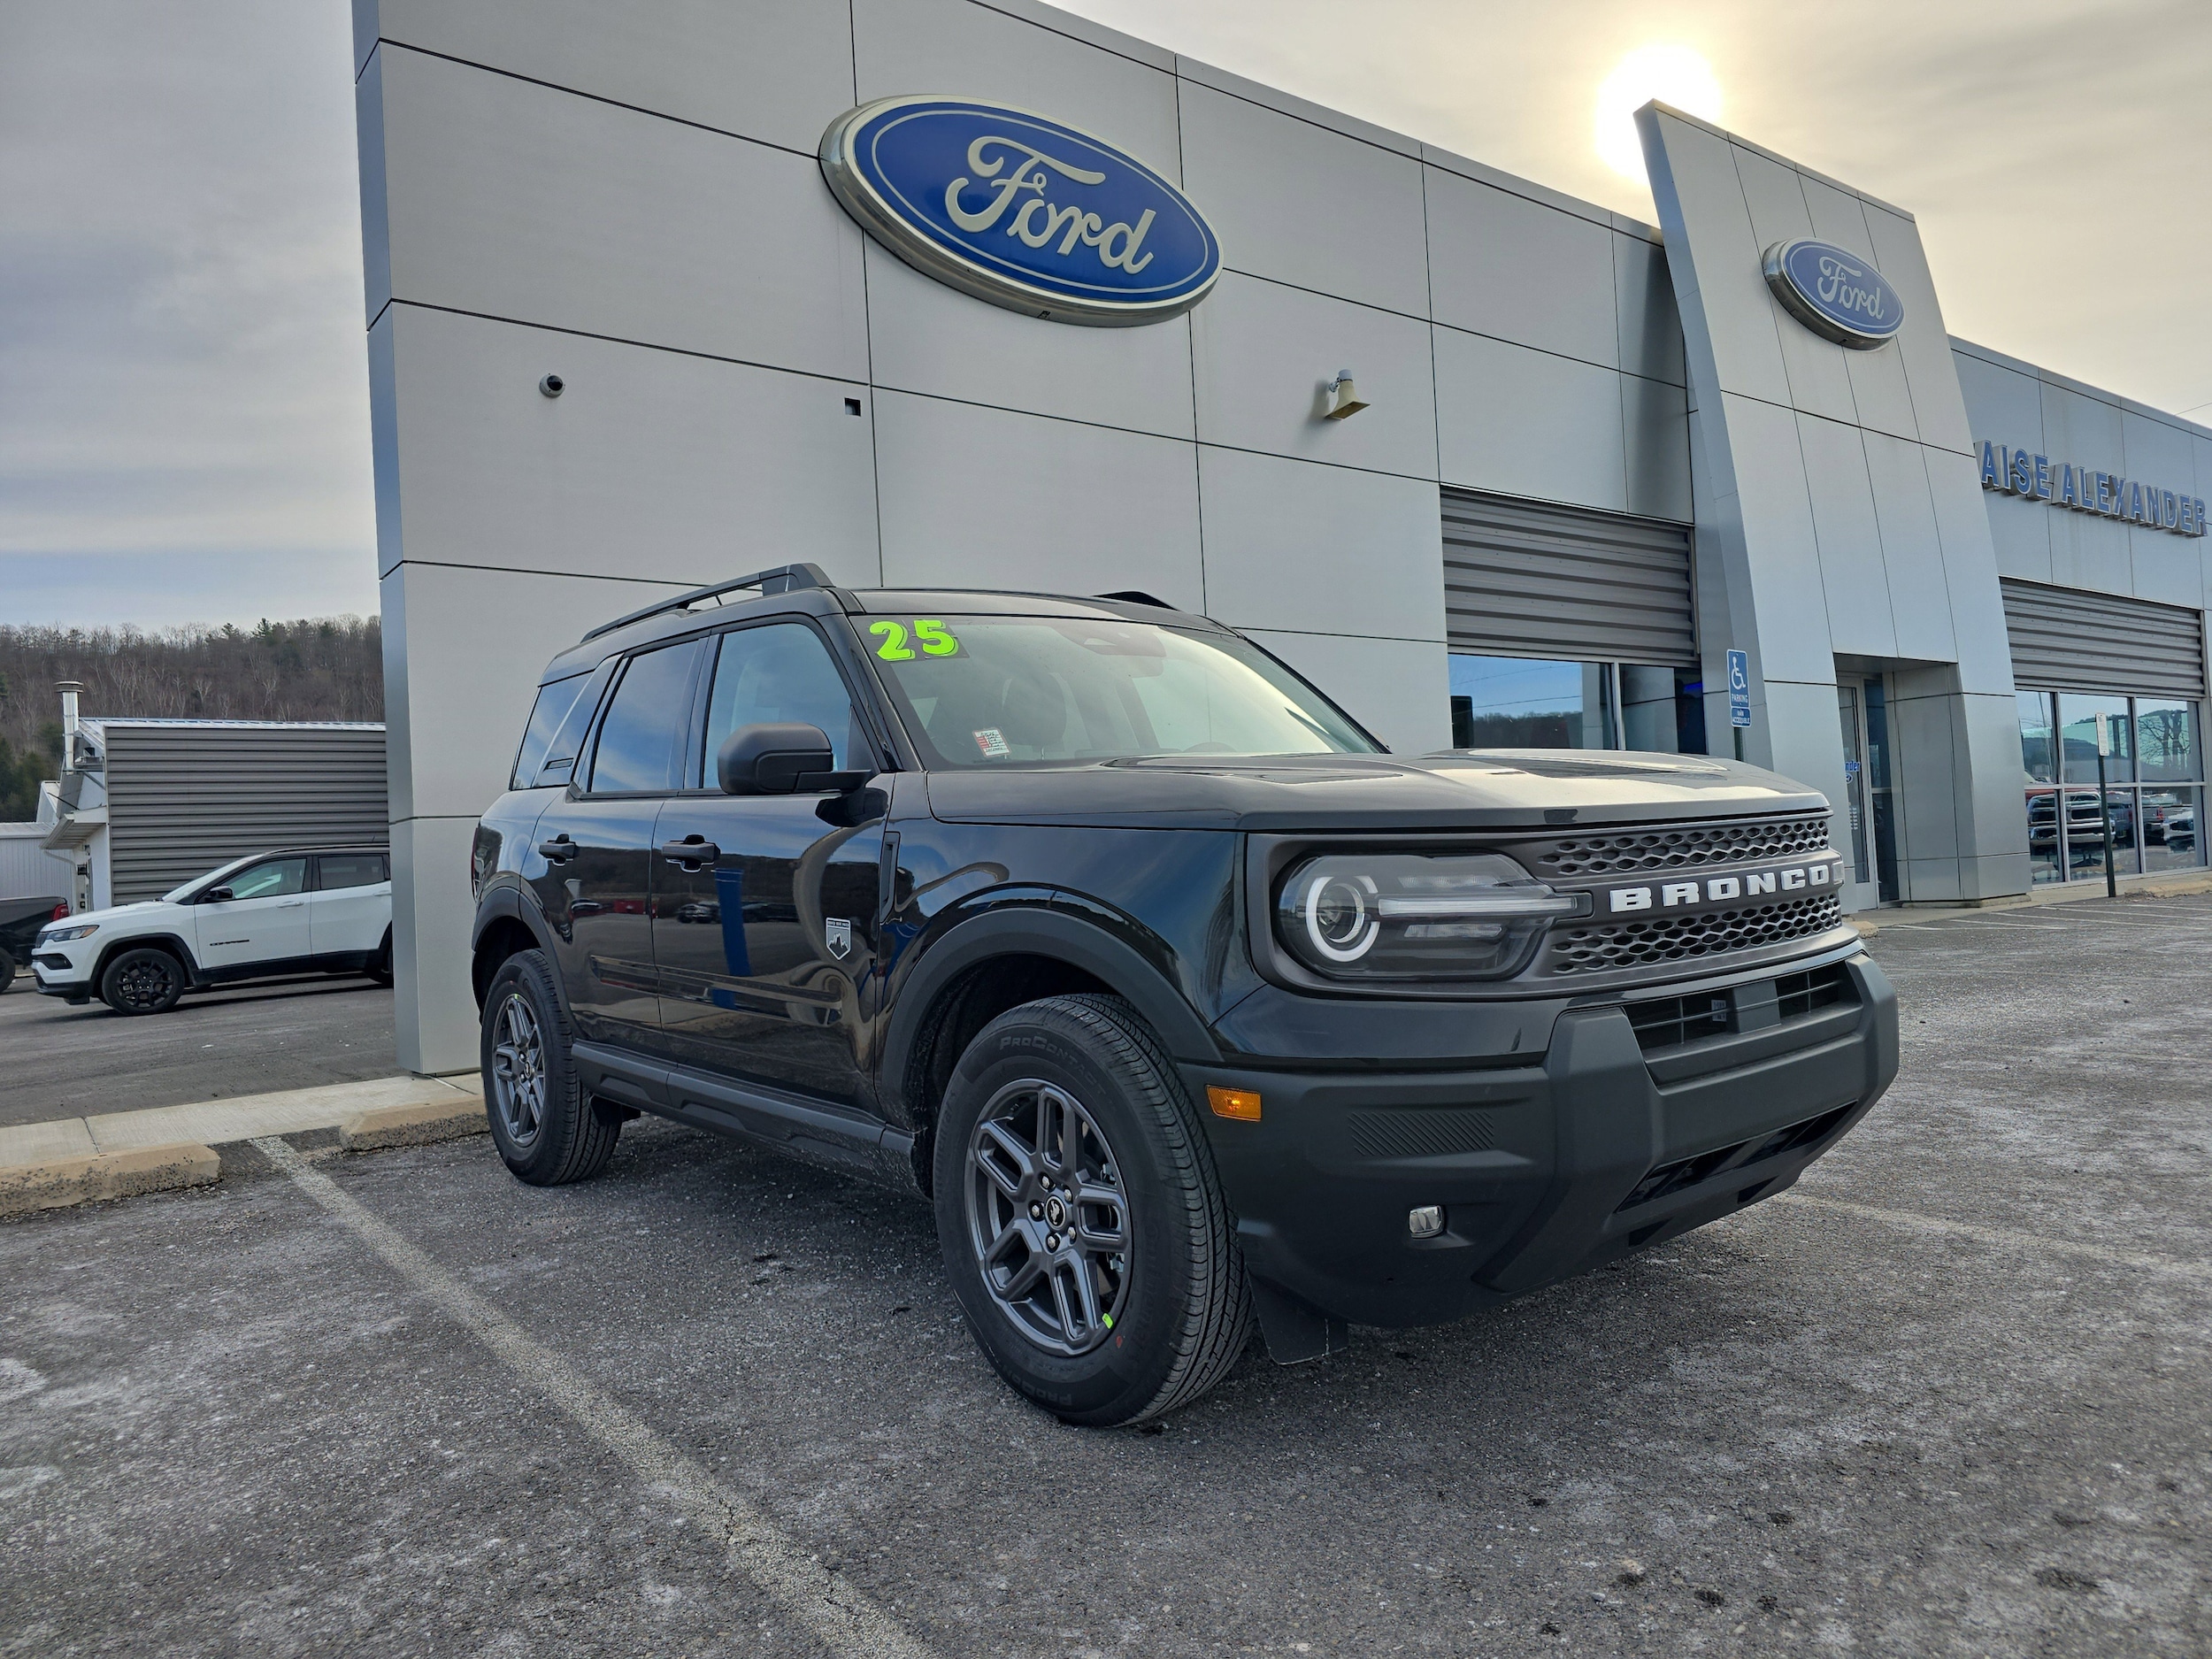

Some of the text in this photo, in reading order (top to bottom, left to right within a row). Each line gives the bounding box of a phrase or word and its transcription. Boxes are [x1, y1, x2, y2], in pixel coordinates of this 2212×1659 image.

[945, 135, 1156, 274] Ford
[1816, 256, 1885, 320] Ford
[1979, 440, 2208, 537] AISE ALEXANDER
[869, 619, 959, 661] 25
[1731, 694, 1748, 703] PARKING
[1609, 864, 1829, 913] BRONCO
